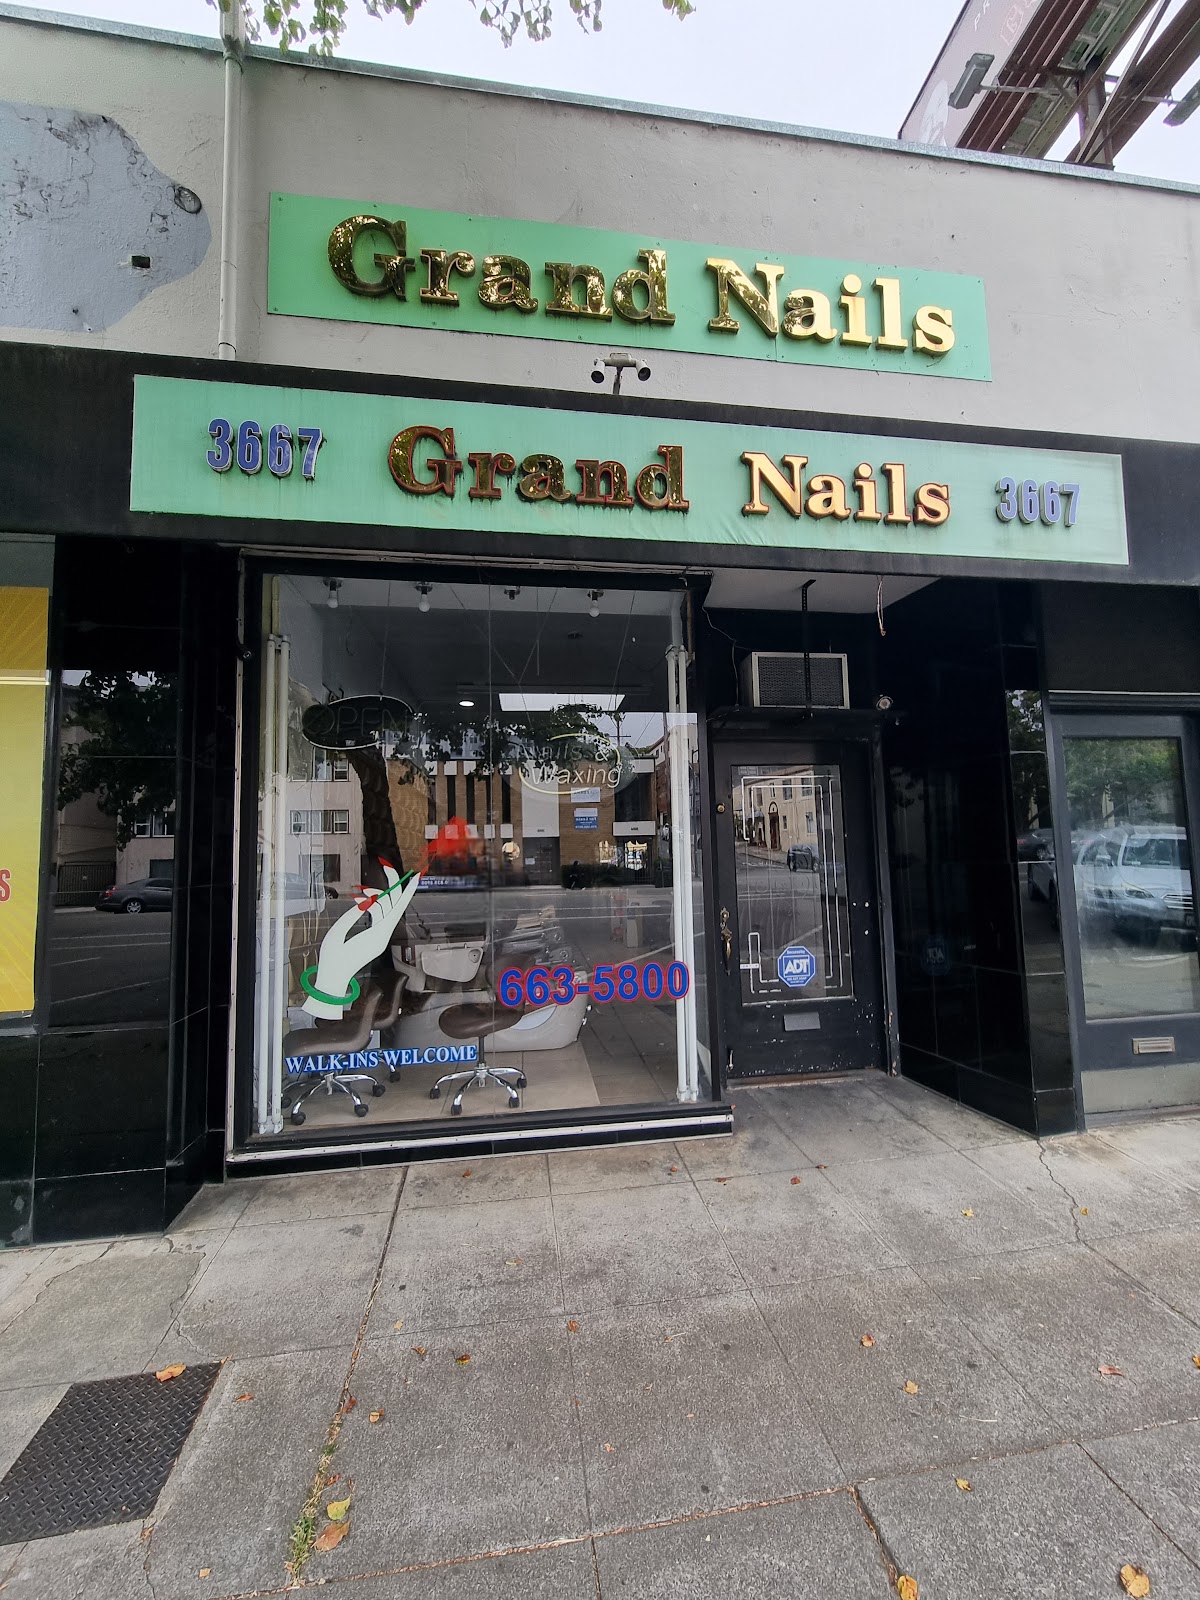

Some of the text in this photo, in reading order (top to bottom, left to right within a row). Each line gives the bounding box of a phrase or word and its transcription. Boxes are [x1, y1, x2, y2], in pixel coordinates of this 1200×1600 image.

[327, 214, 956, 357] Grand Nails
[206, 417, 323, 480] 3667
[388, 425, 951, 526] Grand Nails
[995, 475, 1081, 527] 3667
[530, 764, 622, 788] Waxing
[498, 960, 691, 1008] 663-5800
[785, 959, 809, 974] ADT
[285, 1045, 478, 1074] WALK-INS WELCOME
